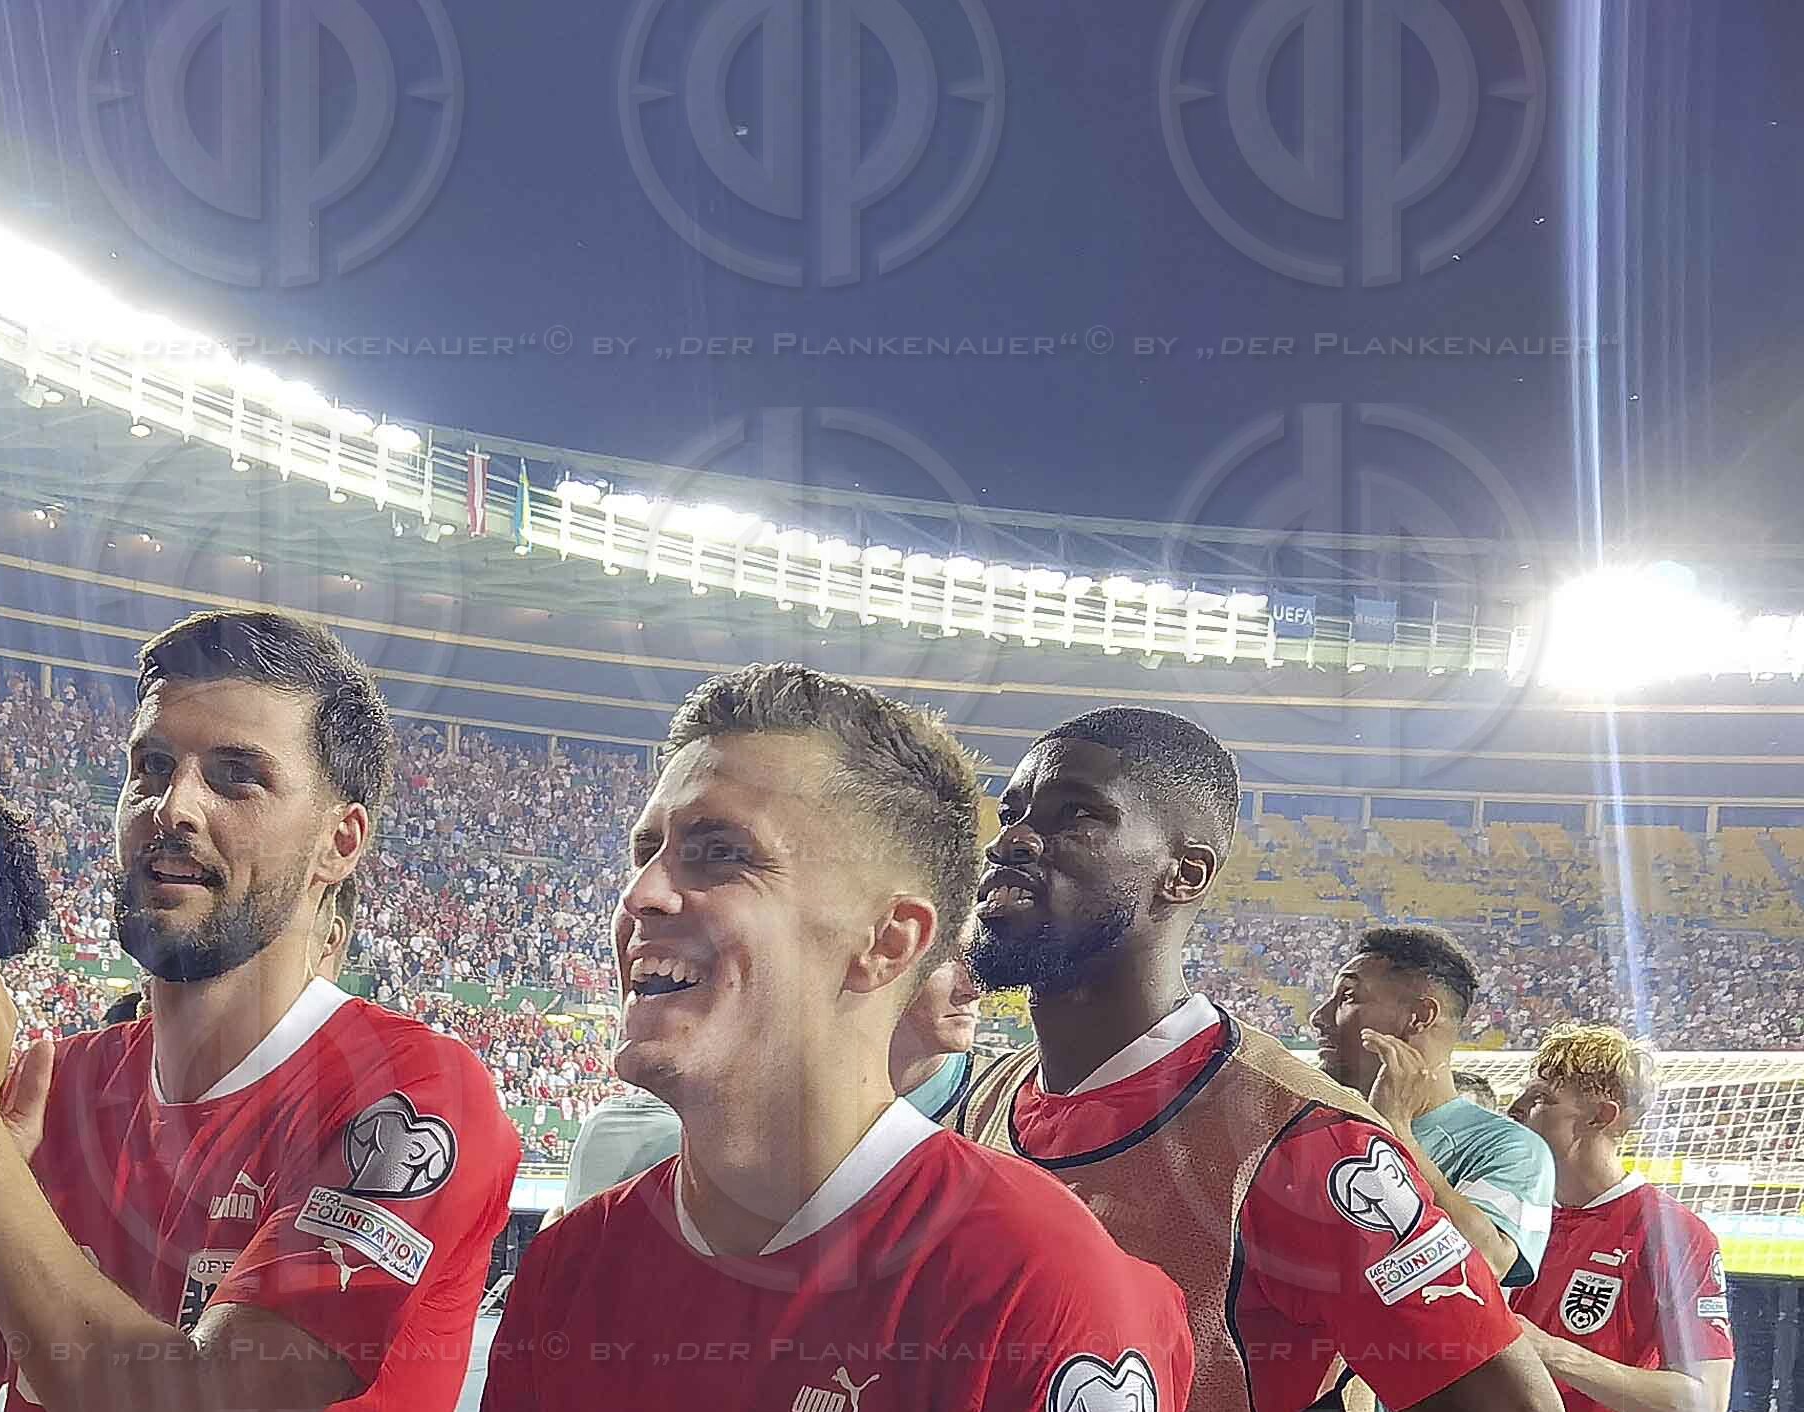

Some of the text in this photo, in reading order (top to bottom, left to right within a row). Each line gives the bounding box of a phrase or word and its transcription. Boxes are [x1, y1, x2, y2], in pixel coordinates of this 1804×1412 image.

[1273, 605, 1313, 625] UEFA
[304, 1200, 424, 1271] FOUNDATION
[1369, 1256, 1397, 1279] UEFA
